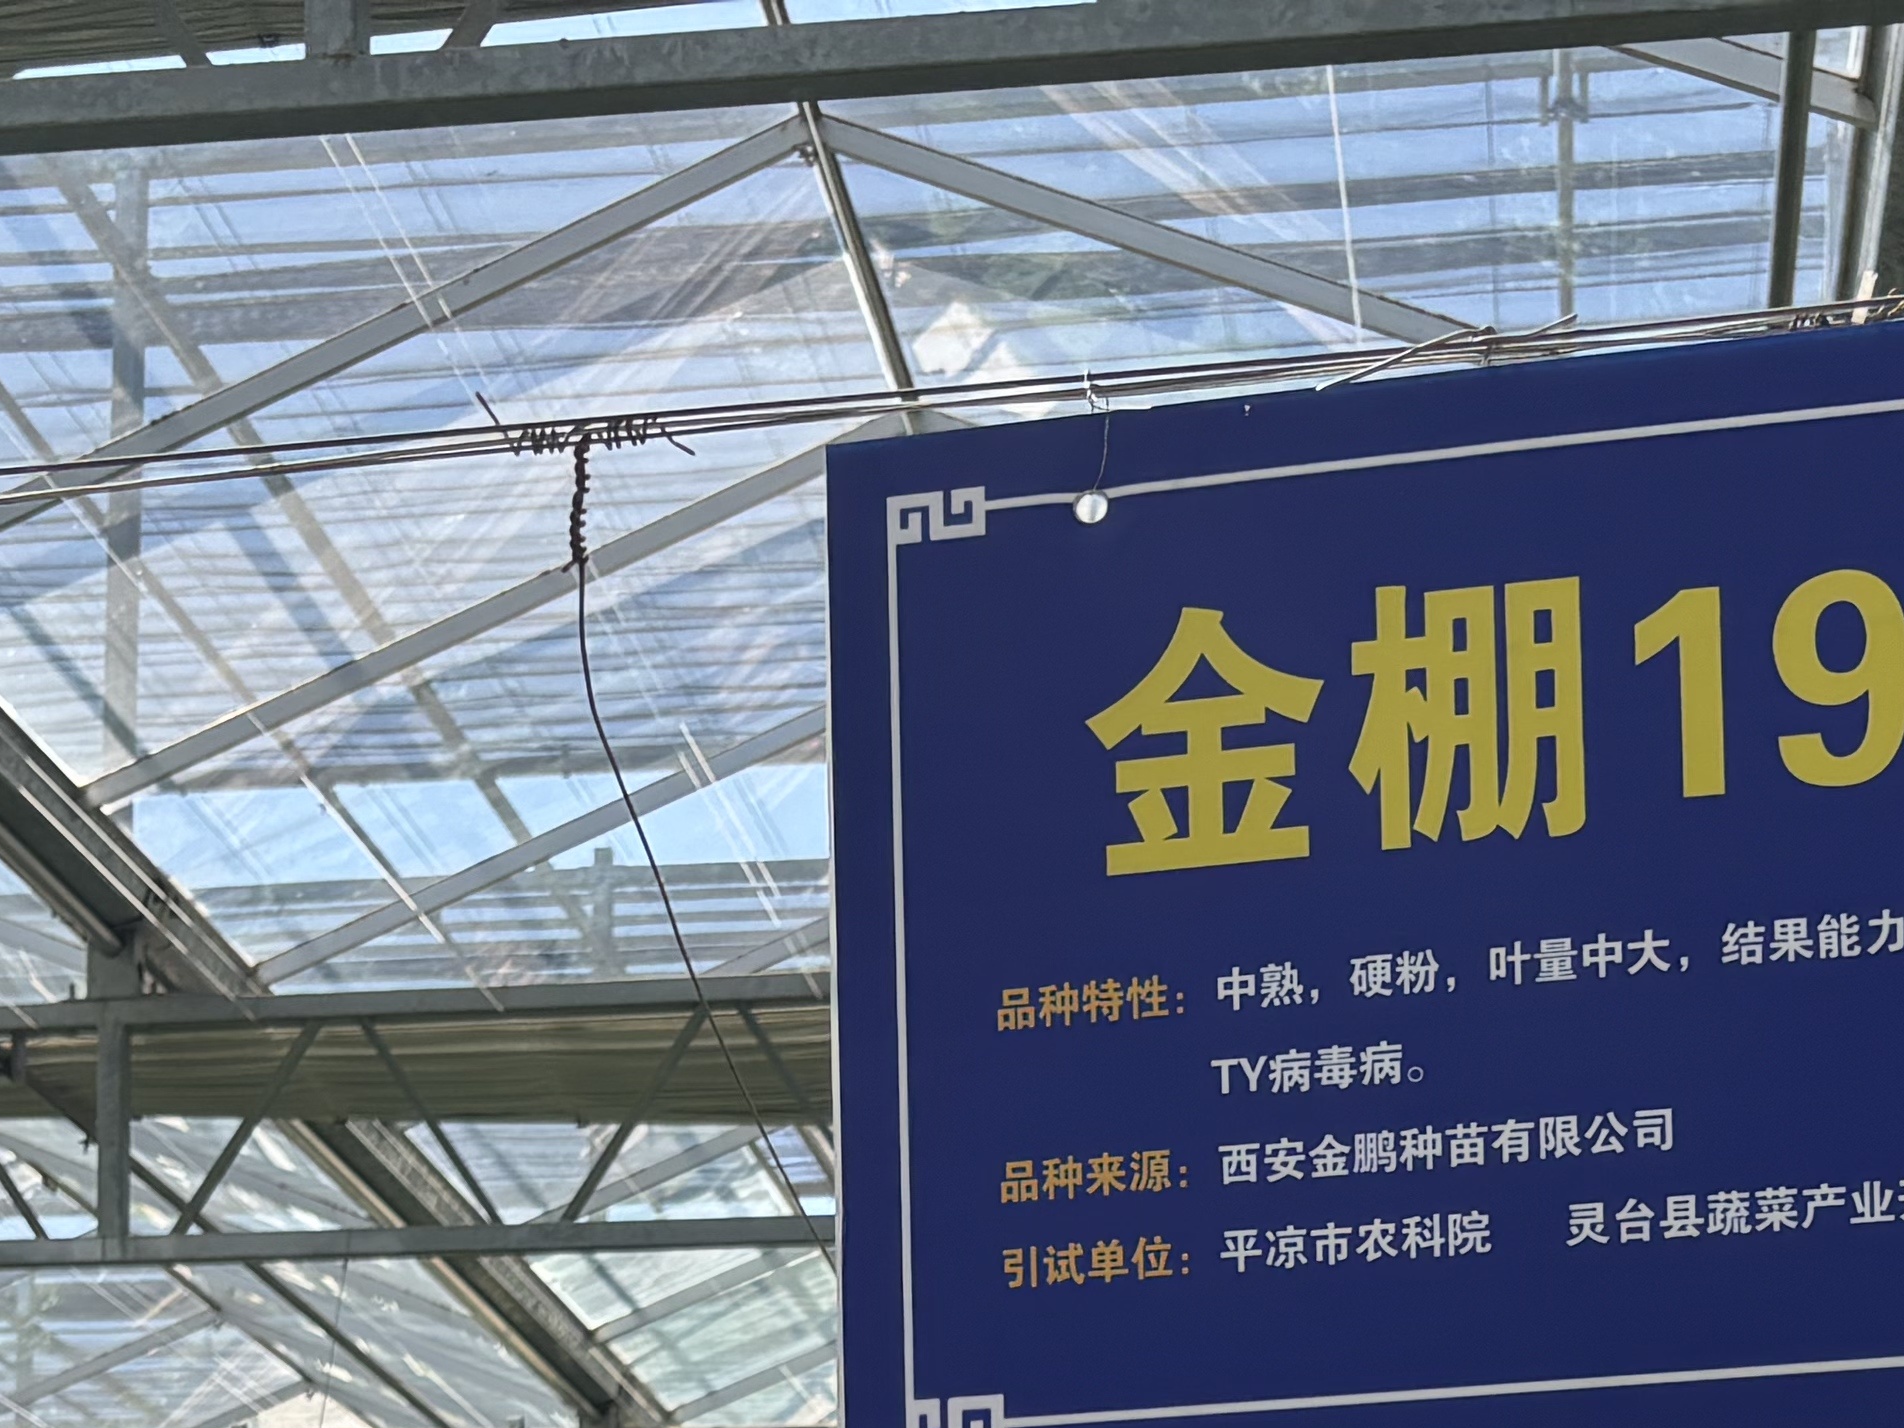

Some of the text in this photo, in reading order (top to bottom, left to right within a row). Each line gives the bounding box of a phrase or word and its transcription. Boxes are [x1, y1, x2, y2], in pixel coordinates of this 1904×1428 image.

[996, 974, 1185, 1032] 品种特性：
[1209, 1040, 1425, 1096] TY病毒病。
[999, 1107, 1674, 1204] 品种来源： 西安金鹏种苗有限公司
[1001, 1235, 1190, 1289] 引试单位：
[1219, 1209, 1493, 1273] 平凉市农科院
